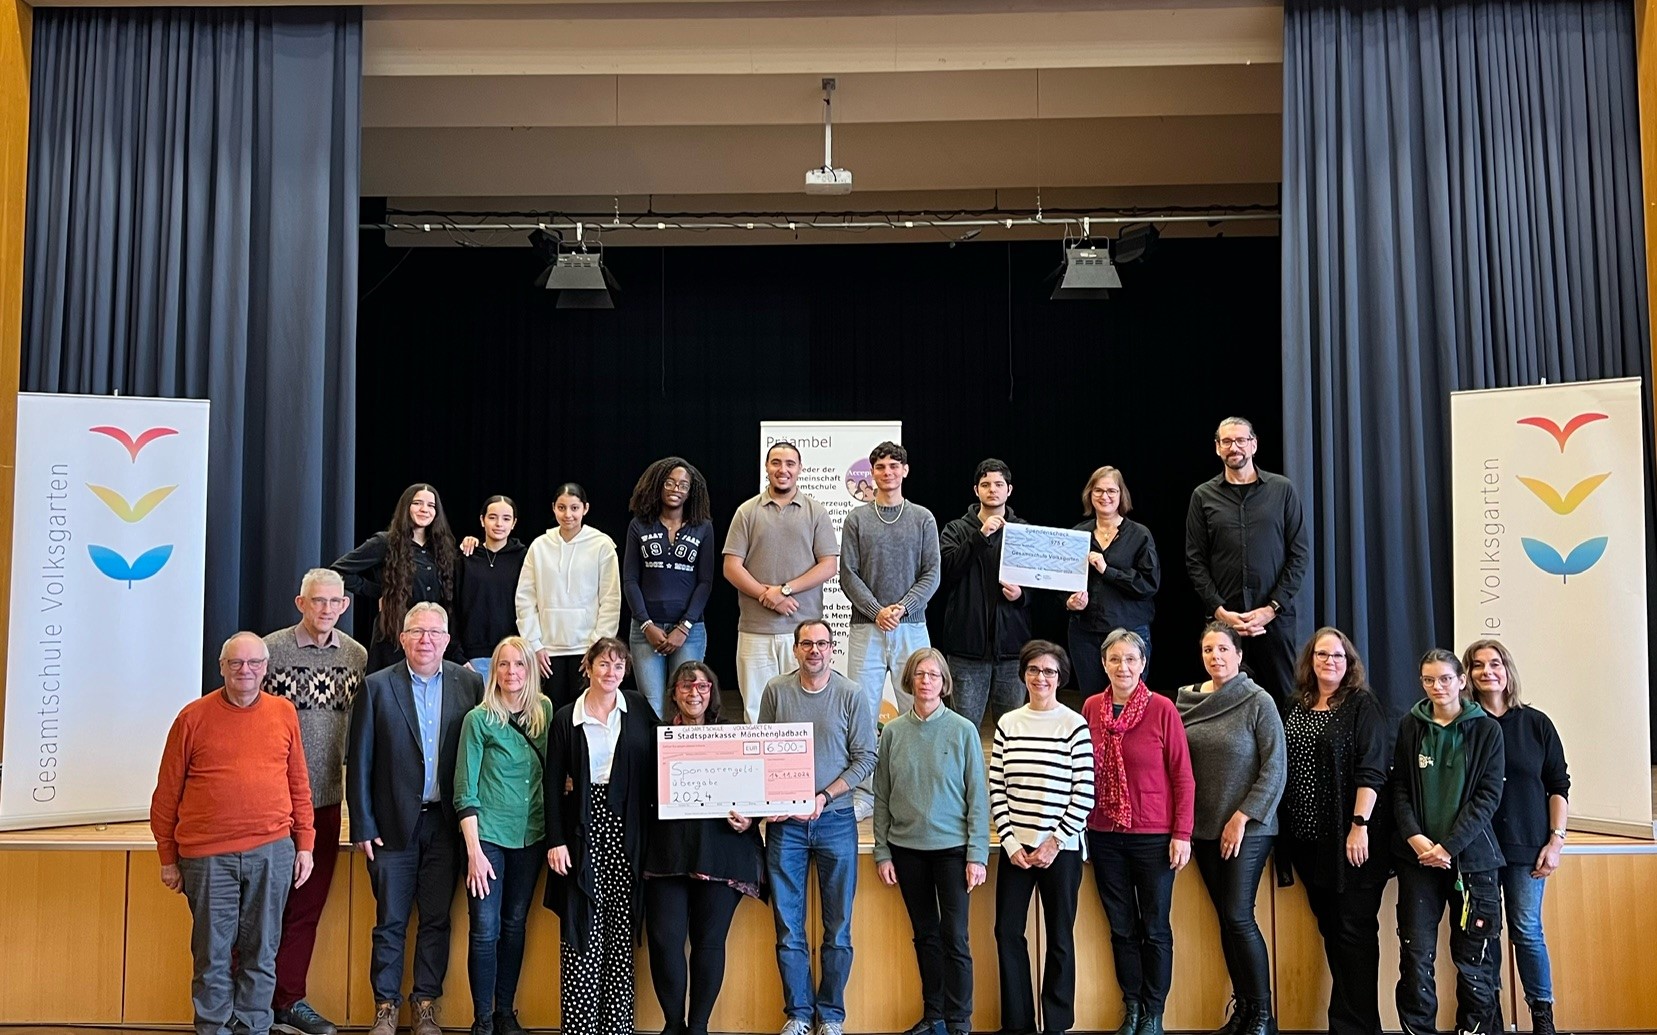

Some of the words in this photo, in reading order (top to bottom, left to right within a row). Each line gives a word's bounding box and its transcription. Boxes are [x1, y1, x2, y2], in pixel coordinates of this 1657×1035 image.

[41, 463, 72, 613] Volksgarten
[1480, 457, 1506, 604] Volksgarten
[33, 624, 63, 803] Gesamtschule
[677, 732, 737, 740] Stadtsparkasse
[740, 729, 808, 739] Mönchengladbach
[672, 779, 718, 790] übergabe
[673, 791, 712, 803] 2024
